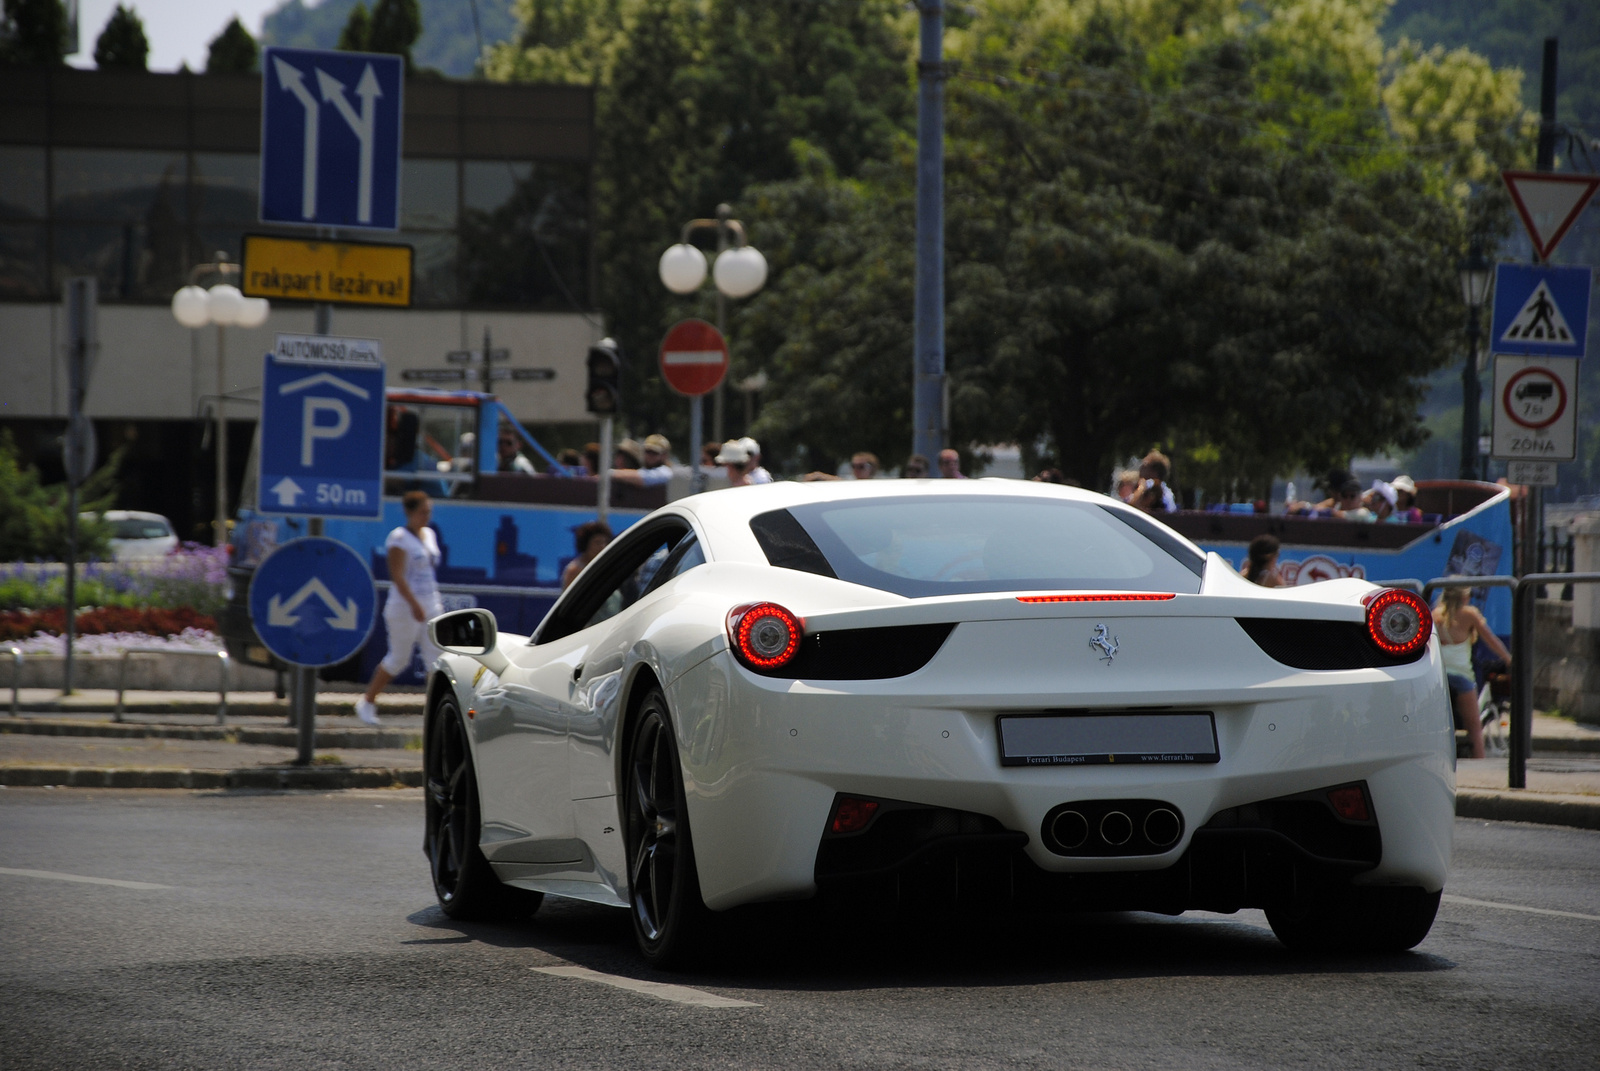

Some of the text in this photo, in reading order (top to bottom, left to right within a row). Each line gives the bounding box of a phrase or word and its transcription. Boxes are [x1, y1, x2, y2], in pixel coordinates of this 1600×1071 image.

[252, 267, 403, 297] rakpart lezárva!
[302, 396, 351, 467] P
[1026, 756, 1085, 764] Ferrari Budapest
